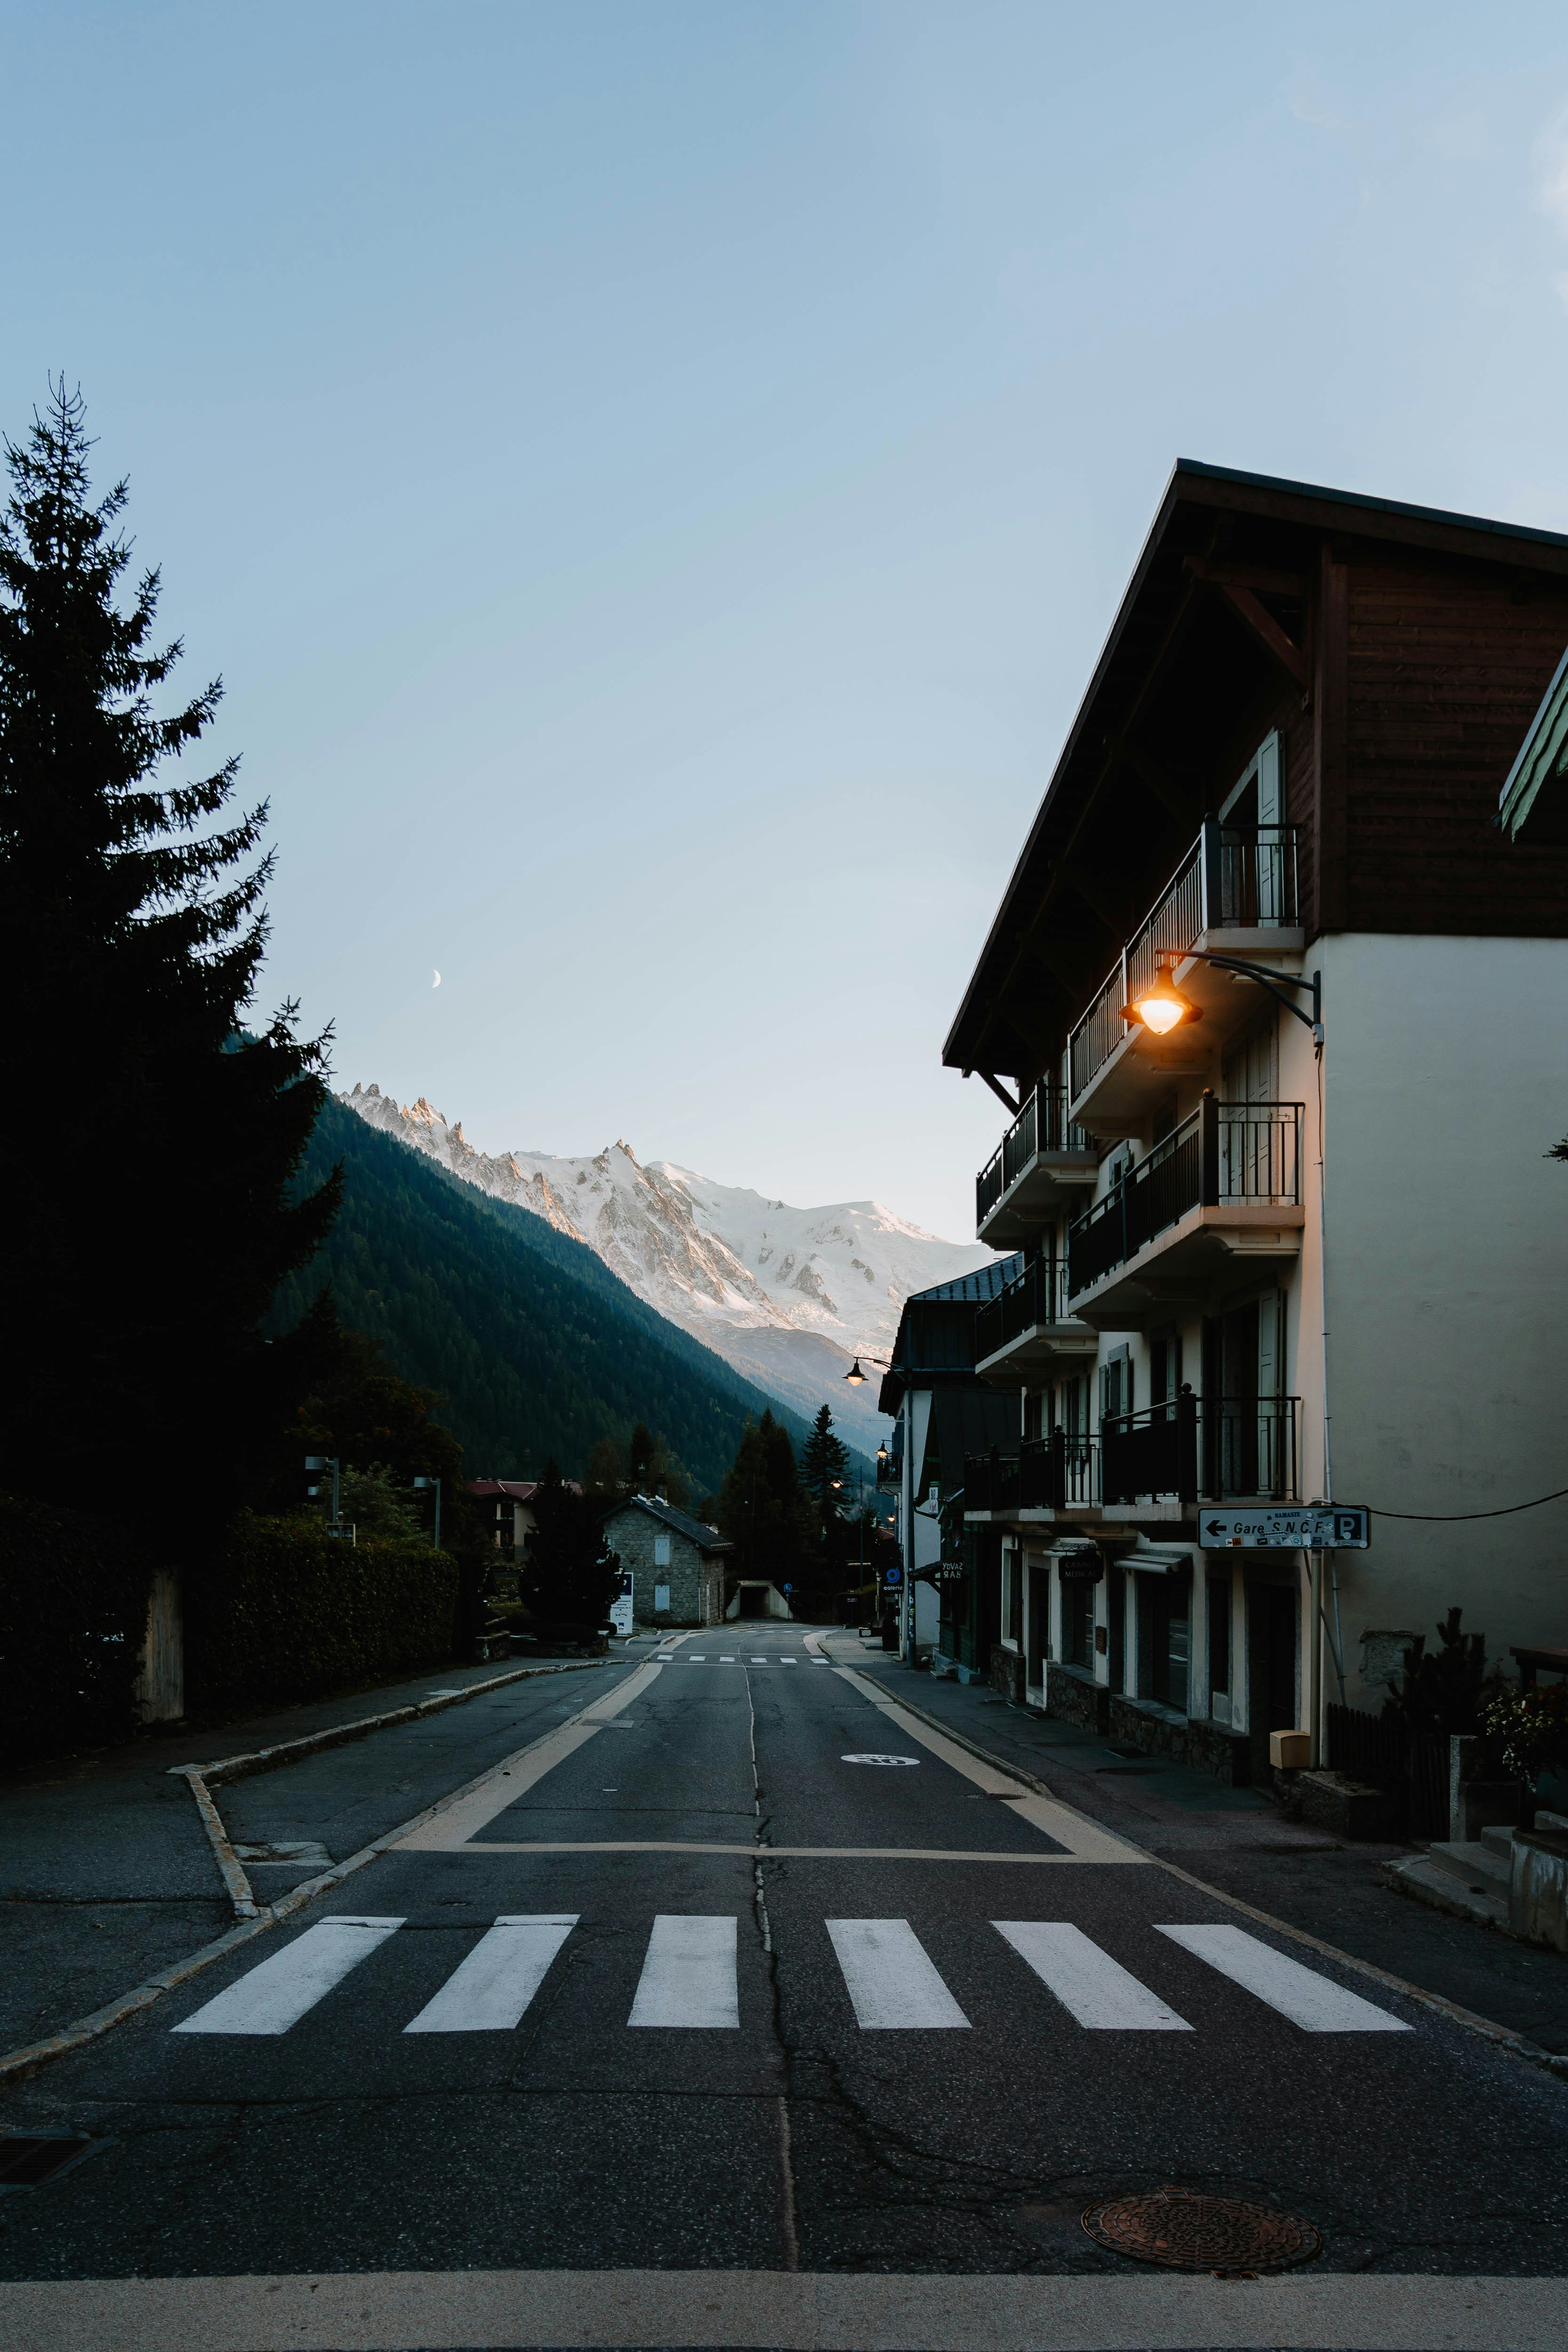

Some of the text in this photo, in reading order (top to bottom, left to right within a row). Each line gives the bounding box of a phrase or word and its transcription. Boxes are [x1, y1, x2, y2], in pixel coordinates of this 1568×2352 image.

[1234, 1522, 1265, 1534] Gare
[1272, 1521, 1325, 1534] SN.C.F.
[1340, 1517, 1355, 1533] P
